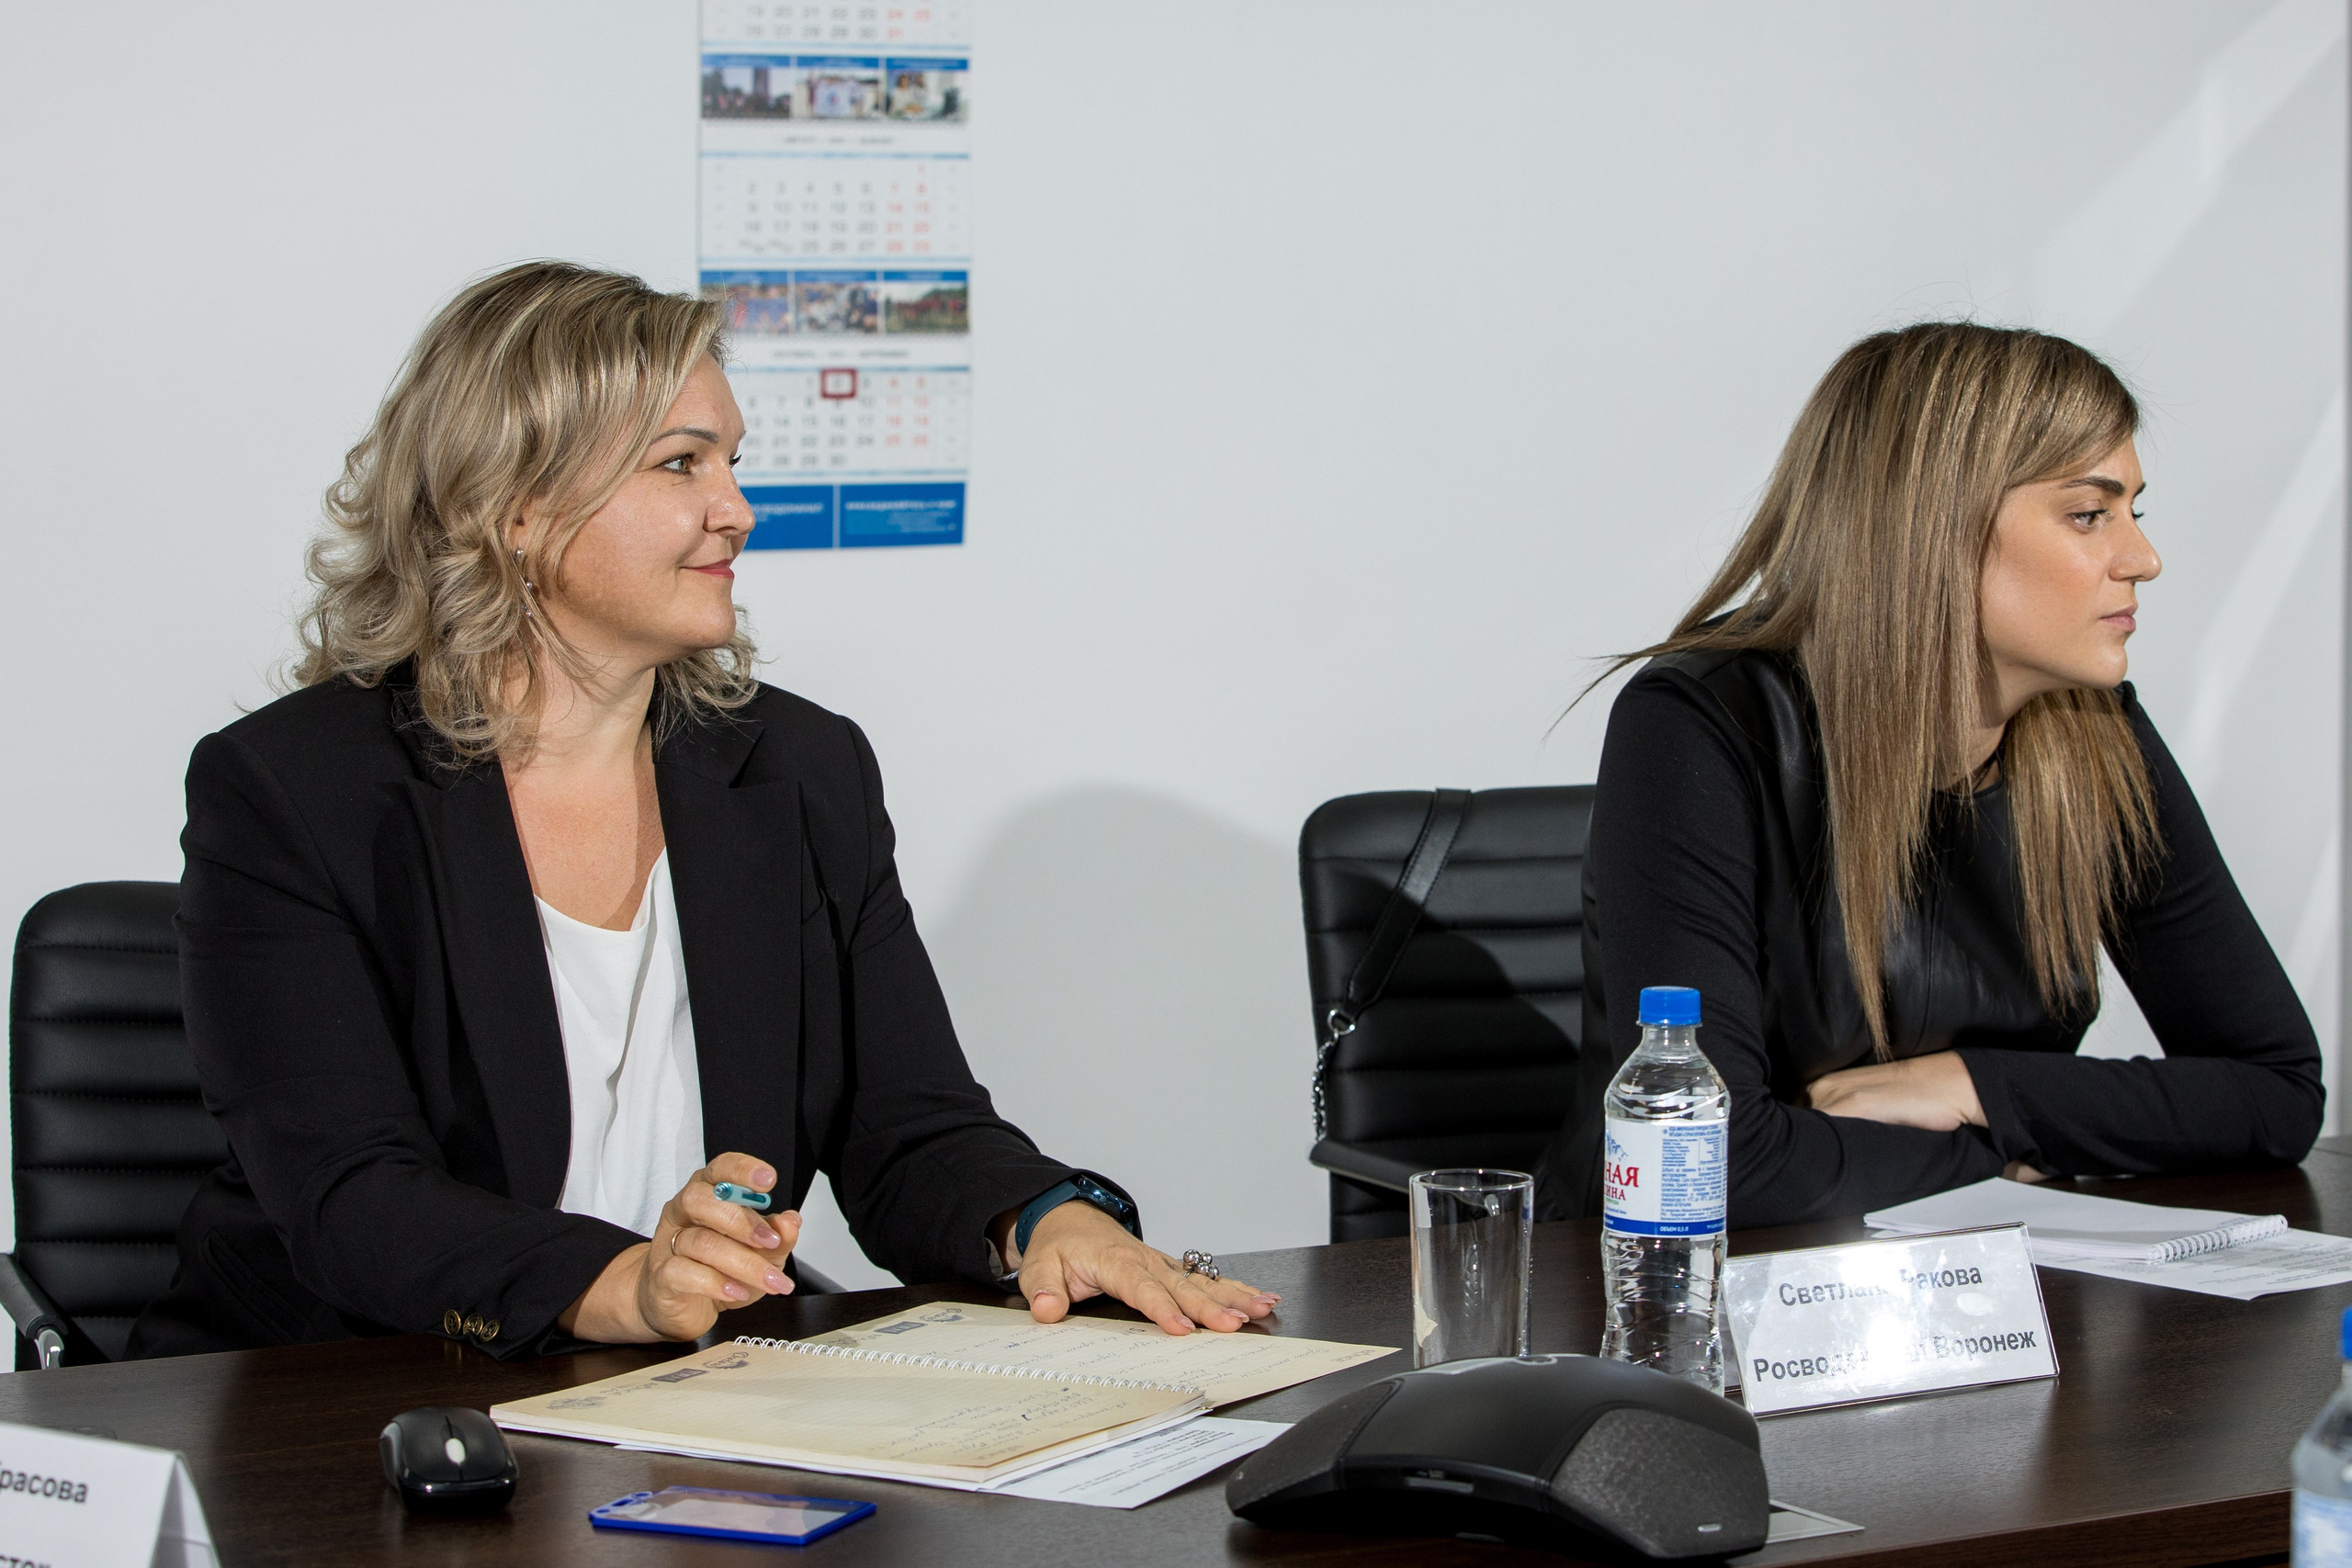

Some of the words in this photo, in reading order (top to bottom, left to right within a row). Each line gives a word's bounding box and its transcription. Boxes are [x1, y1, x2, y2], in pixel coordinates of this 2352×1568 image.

[1779, 1281, 1889, 1307] Светлан
[1932, 1330, 2037, 1361] Воронеж
[0, 1468, 89, 1504] расова
